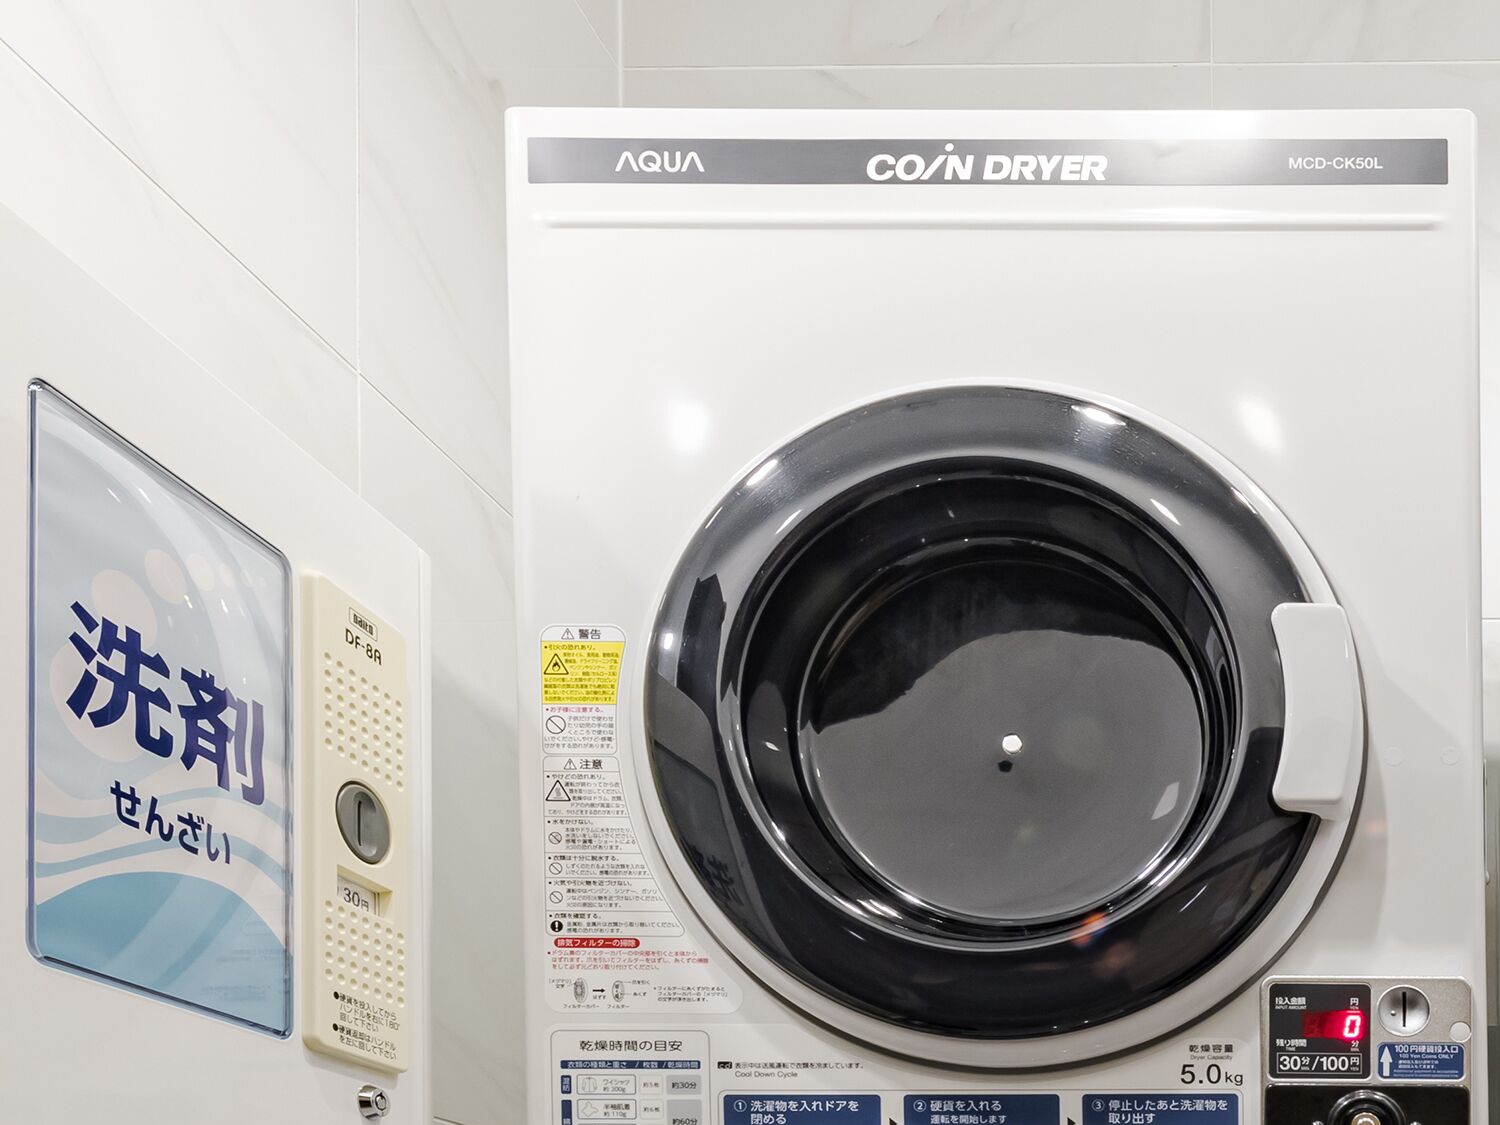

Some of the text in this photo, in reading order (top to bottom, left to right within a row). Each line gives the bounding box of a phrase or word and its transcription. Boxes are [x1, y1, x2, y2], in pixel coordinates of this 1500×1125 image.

[615, 152, 705, 173] AQUA
[984, 154, 1108, 181] DRYER
[1288, 155, 1384, 171] MCD-CK50L
[578, 628, 602, 640] 警告
[345, 628, 382, 665] DF-8A
[65, 600, 266, 805] 洗剤
[580, 759, 603, 770] 注意
[110, 780, 232, 865] せんざい
[344, 888, 369, 912] 30円
[557, 939, 635, 947] 排気フィルターの掃除
[1344, 1015, 1361, 1037] 0
[579, 1040, 683, 1051] 乾燥時間の目安
[1189, 1044, 1233, 1053] 乾燥容量
[1276, 1039, 1307, 1047] 残り時間
[778, 1071, 798, 1079] Cycle
[751, 1100, 859, 1112] 洗濯物を入れドアを
[930, 1100, 1002, 1112] 硬貨を入れる
[1108, 1100, 1227, 1111] 停止したあと洗濯物を
[751, 1114, 787, 1125] 閉める
[930, 1114, 1007, 1124] 運転を開始します
[1108, 1113, 1156, 1124] 取り出す
